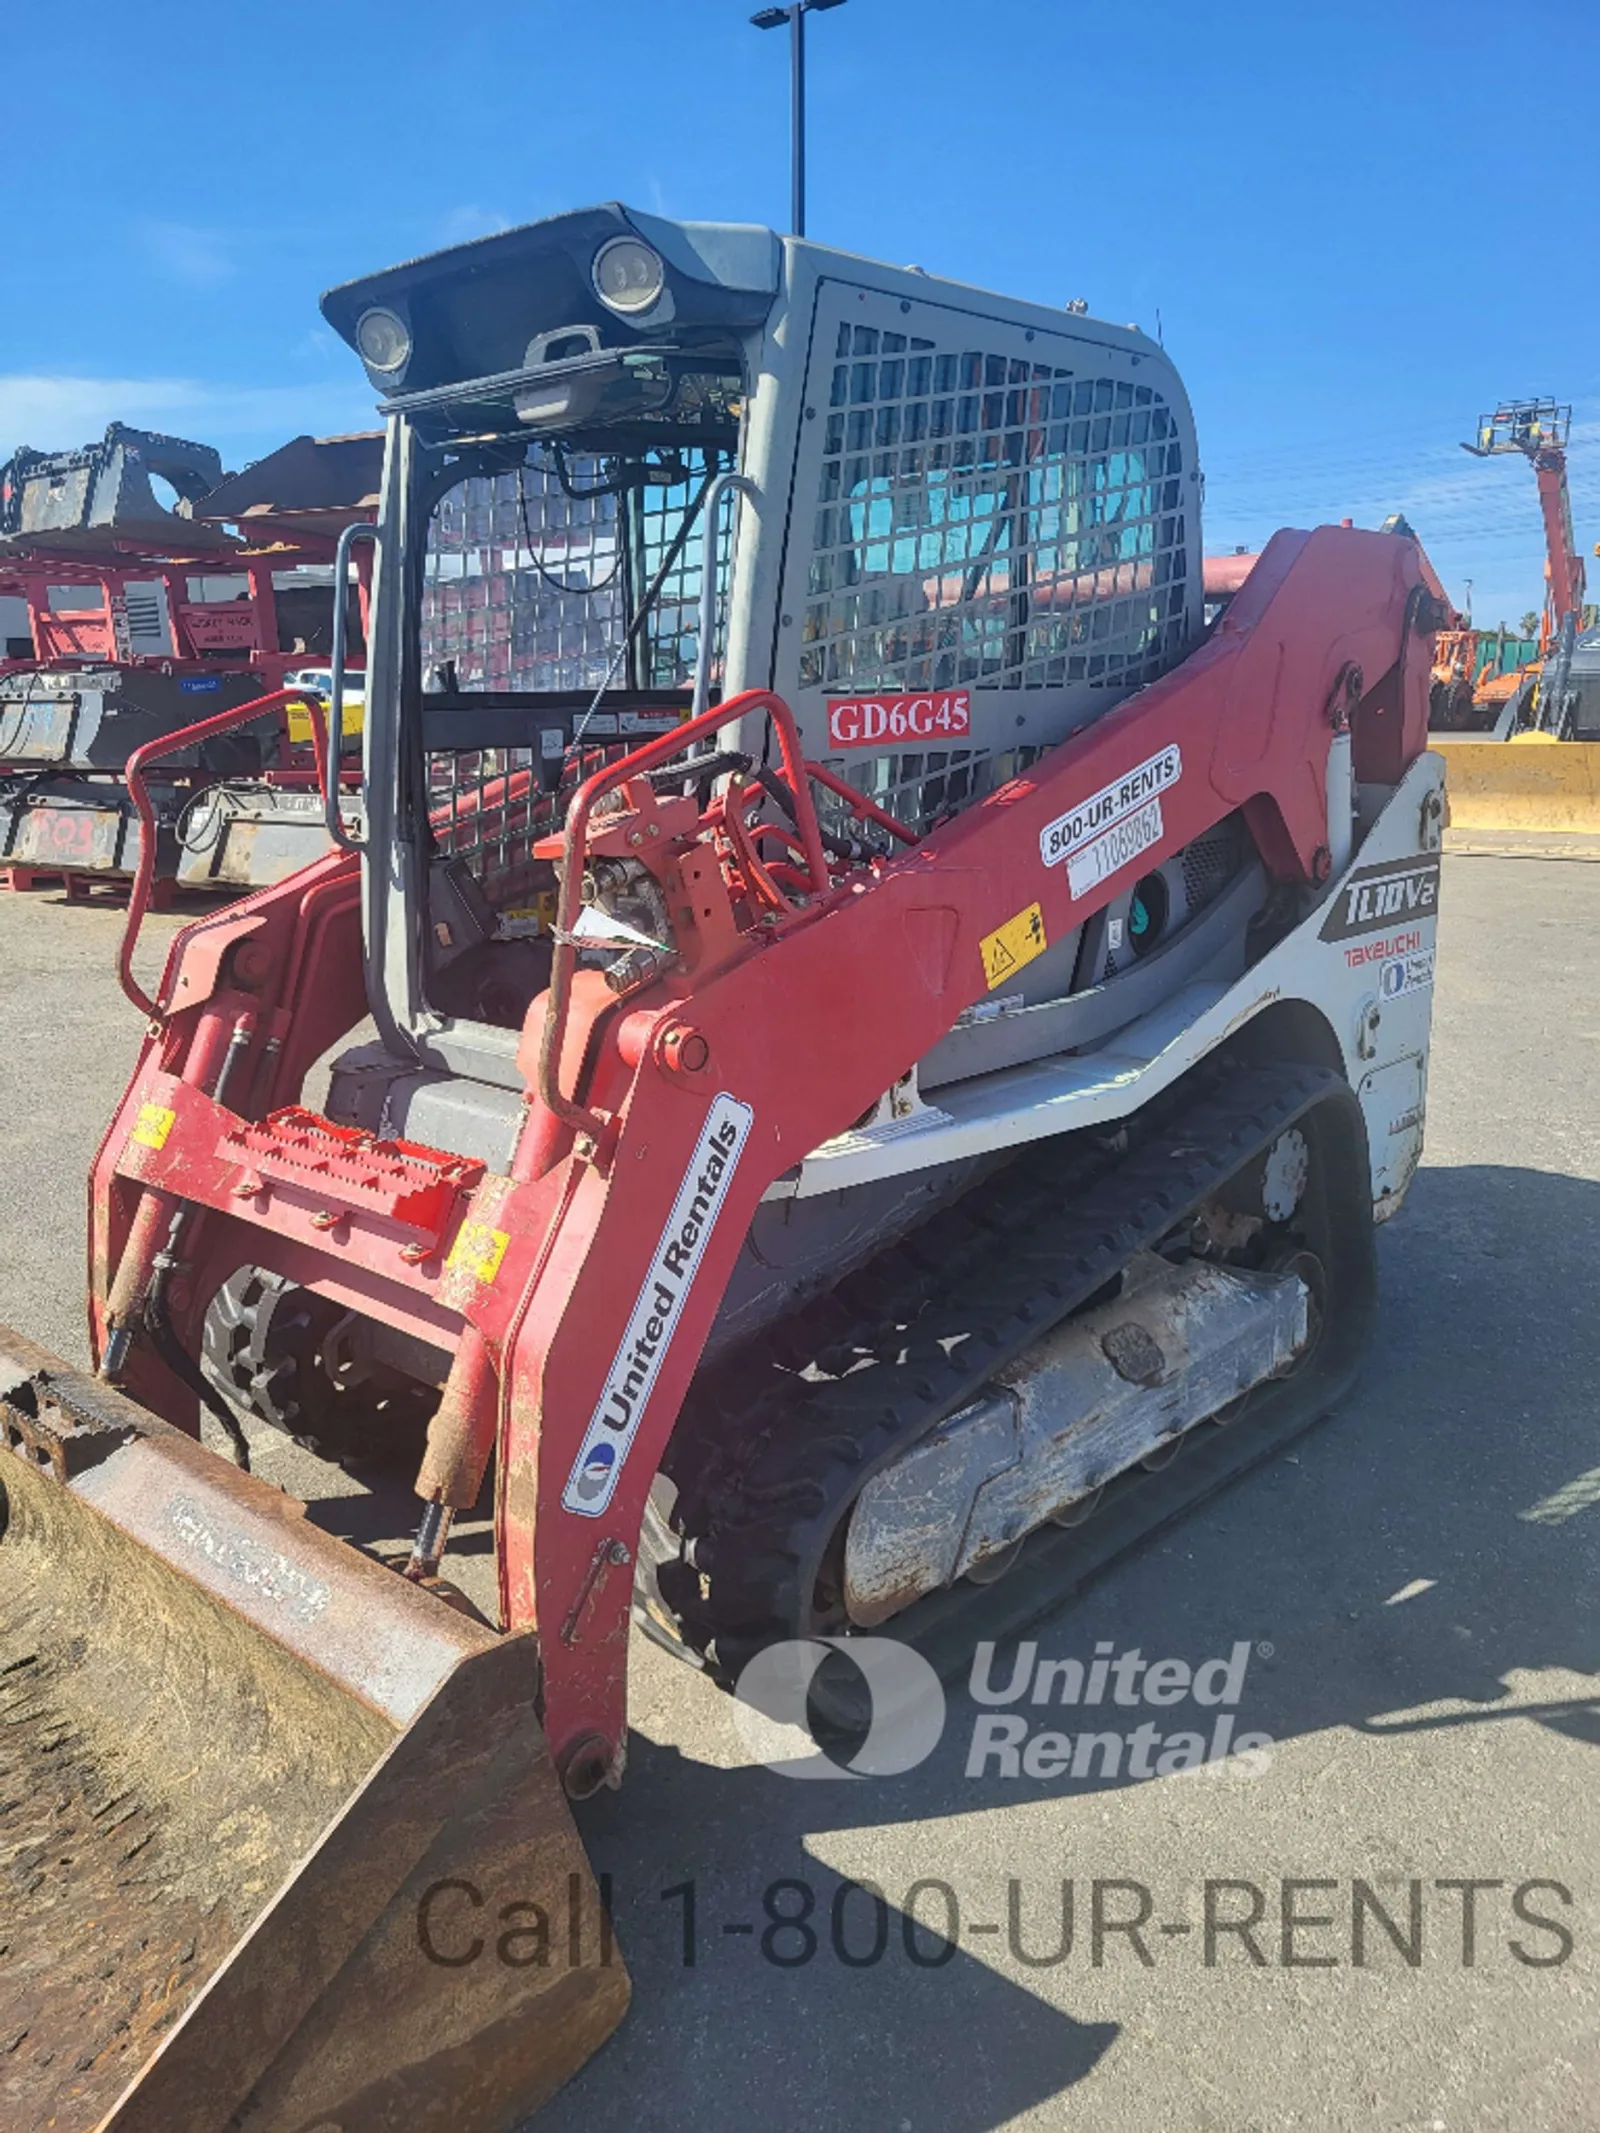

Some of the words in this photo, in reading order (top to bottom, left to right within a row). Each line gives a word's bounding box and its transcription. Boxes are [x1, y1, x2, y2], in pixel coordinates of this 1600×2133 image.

[831, 697, 968, 741] GD6G45
[1050, 756, 1174, 855] 800-UR-RENTS
[602, 1283, 675, 1433] United
[663, 1119, 738, 1279] Rentals
